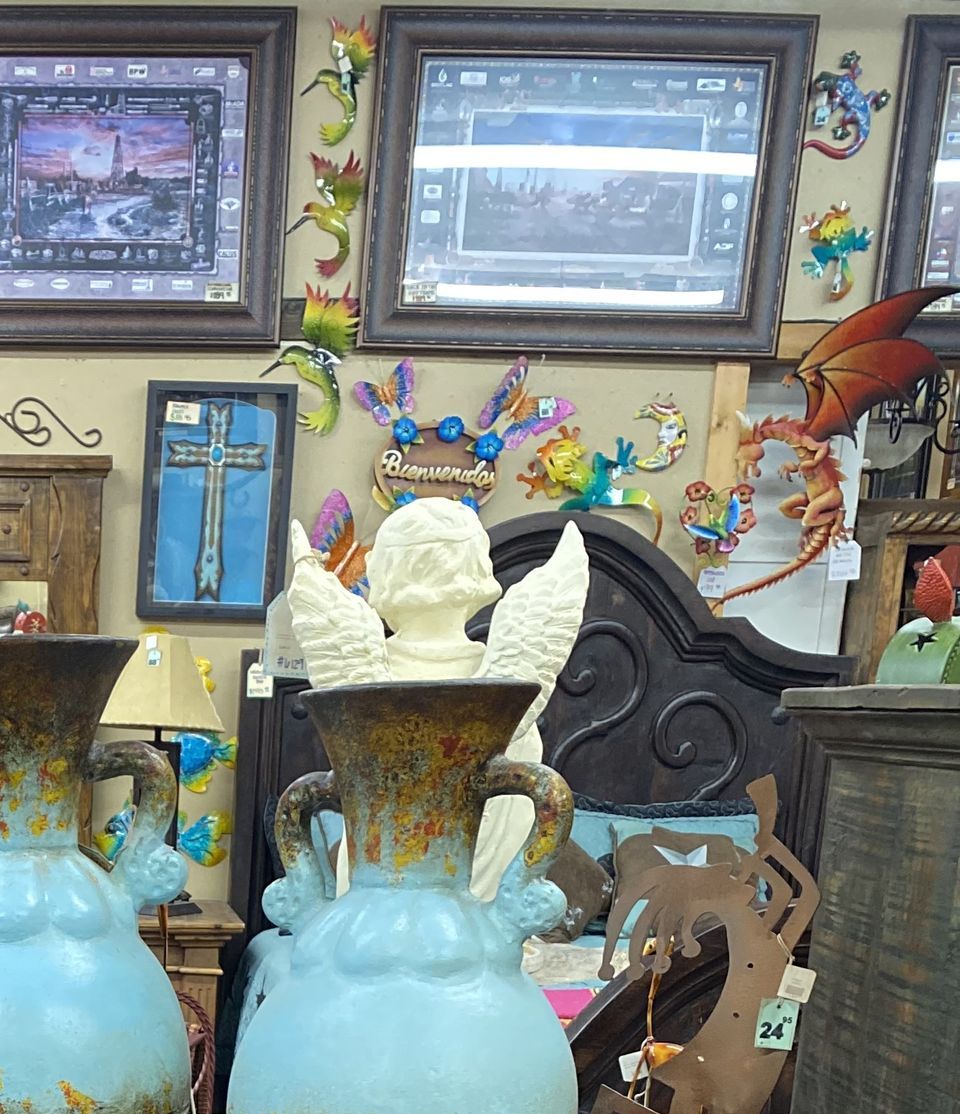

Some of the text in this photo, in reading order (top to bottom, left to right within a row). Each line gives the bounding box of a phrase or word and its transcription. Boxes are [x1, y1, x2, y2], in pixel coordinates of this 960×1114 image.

[381, 450, 496, 490] Bienvenidos
[760, 1016, 793, 1040] 24 95
